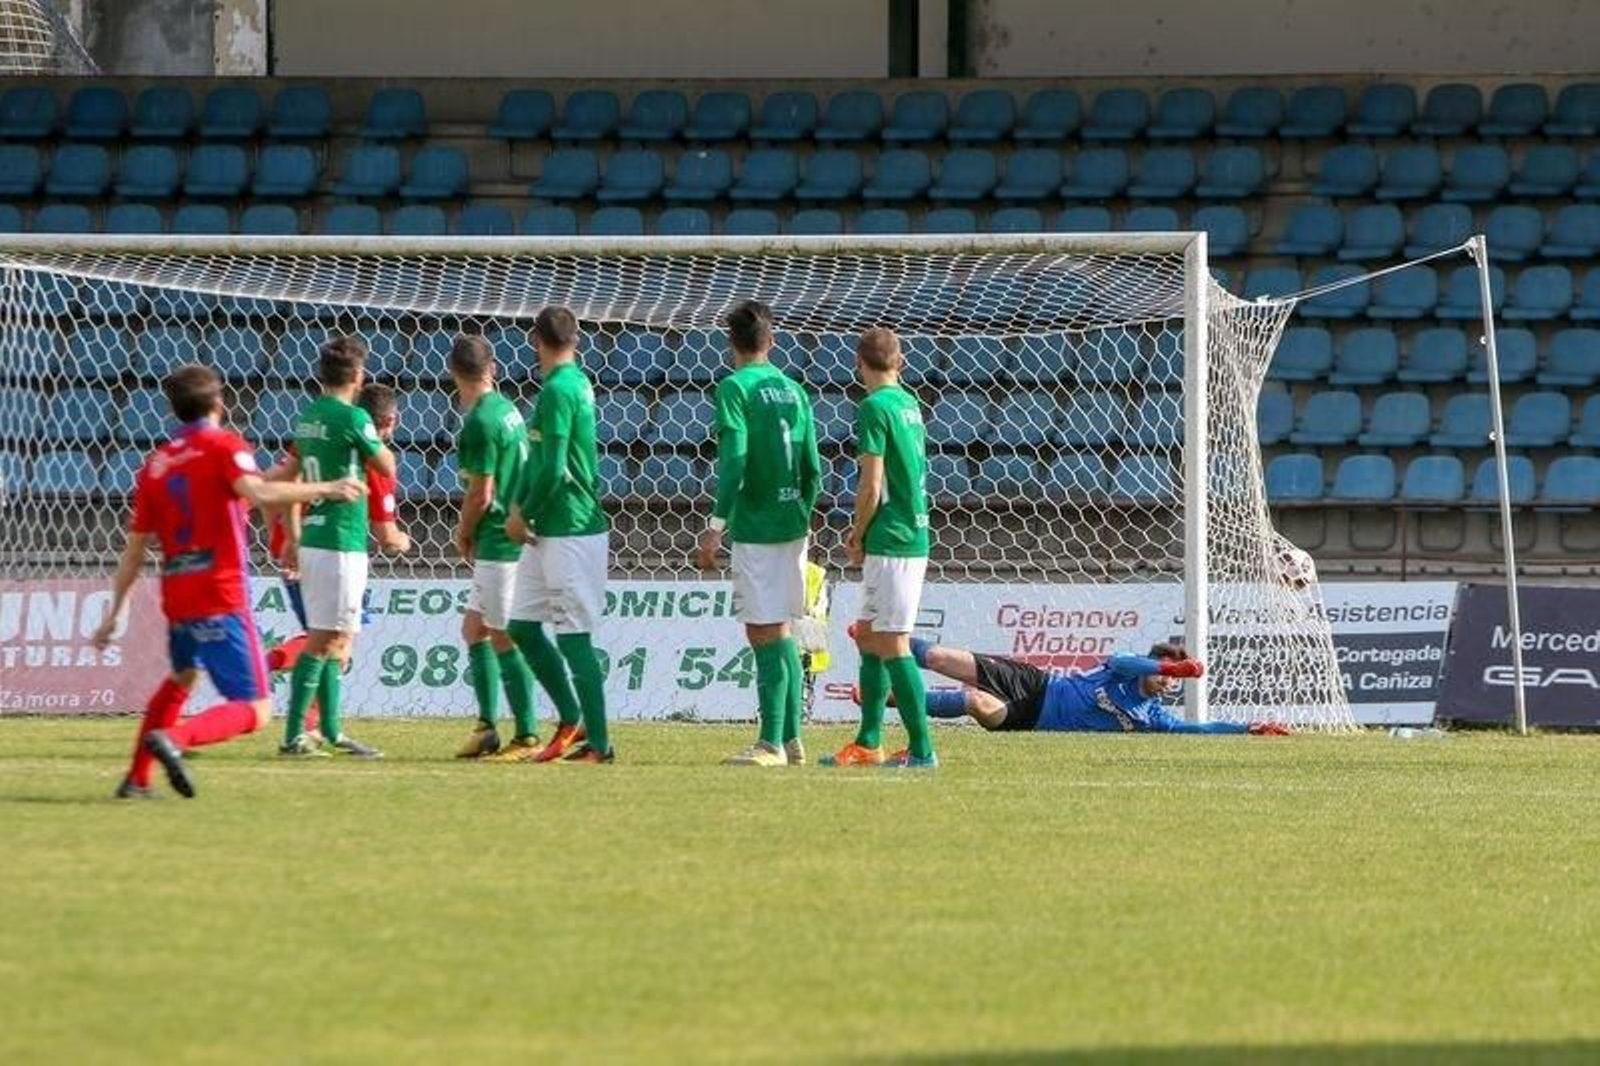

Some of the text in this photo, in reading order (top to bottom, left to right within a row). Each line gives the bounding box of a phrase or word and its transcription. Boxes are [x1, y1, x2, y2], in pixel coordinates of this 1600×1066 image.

[996, 604, 1139, 628] Celanova
[1013, 630, 1115, 654] Motor
[1336, 645, 1441, 666] Cortegada
[379, 645, 476, 687] 98
[676, 647, 756, 690] 54
[1360, 671, 1433, 690] Cañiza
[0, 690, 80, 708] Zamora
